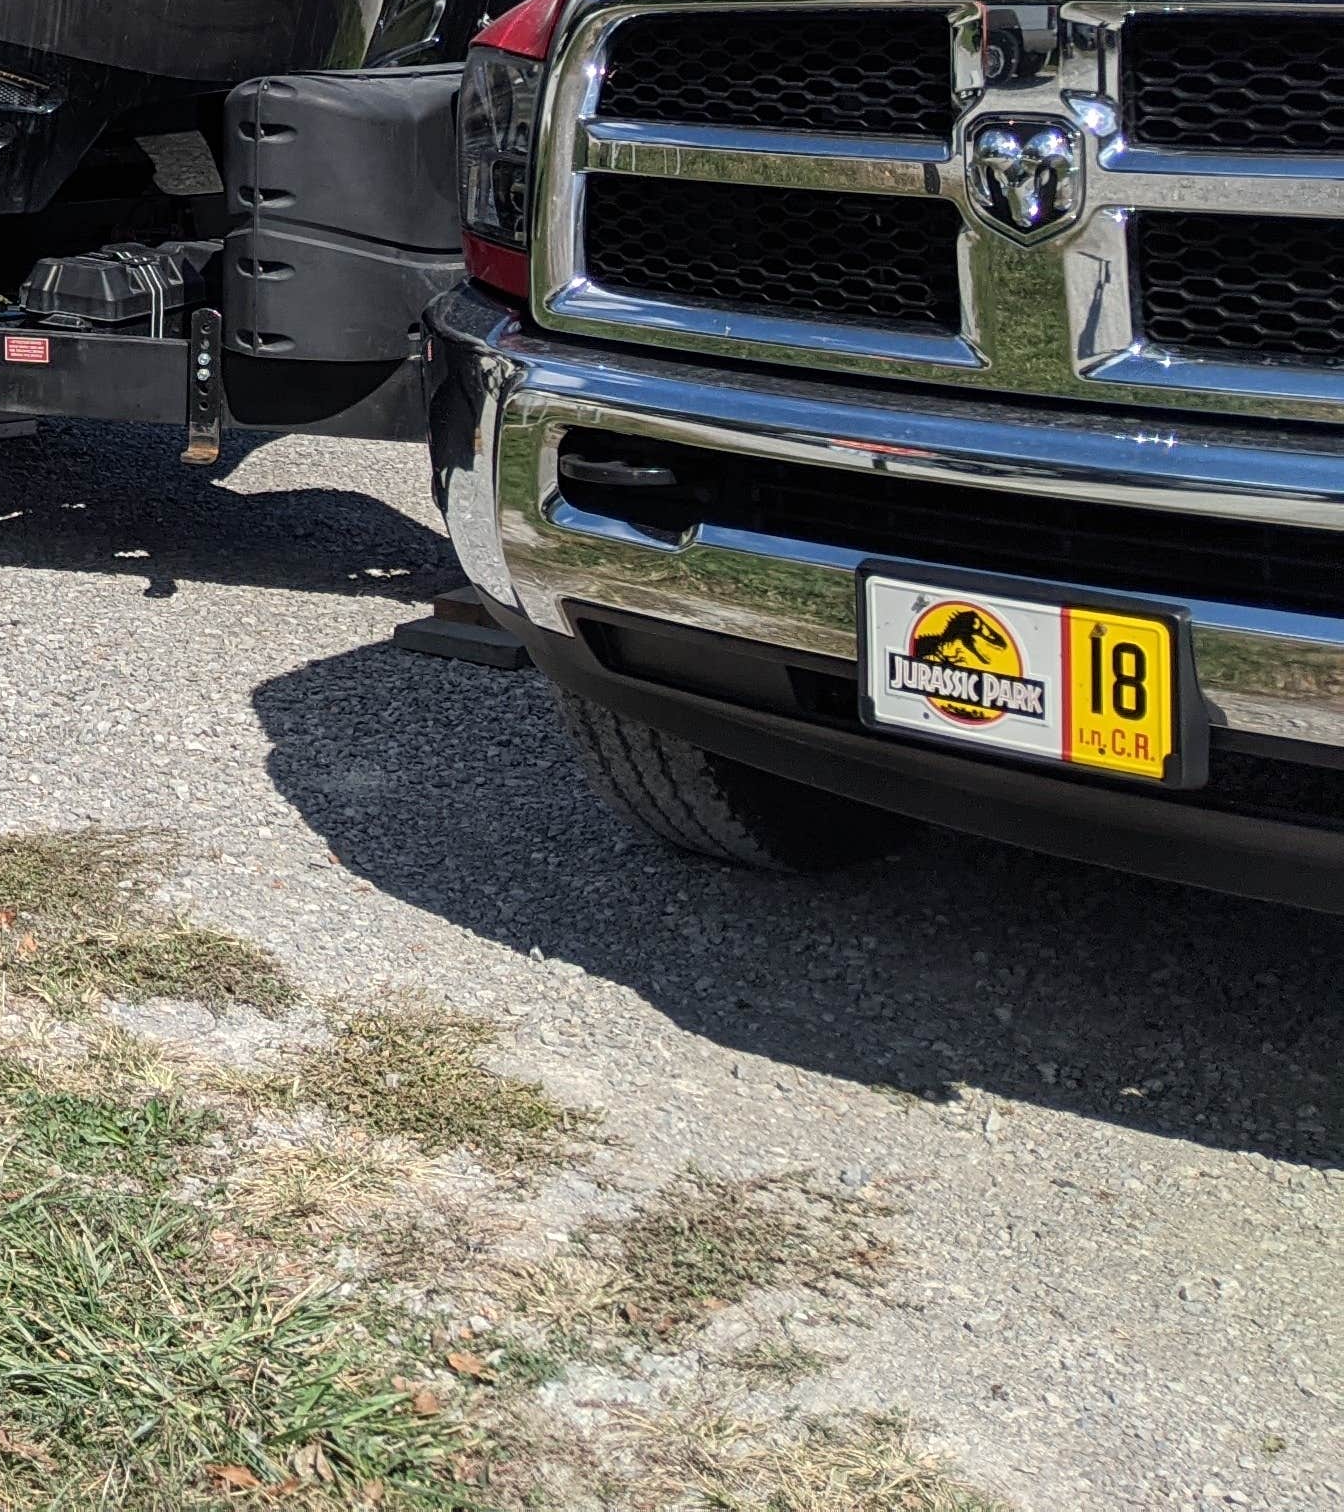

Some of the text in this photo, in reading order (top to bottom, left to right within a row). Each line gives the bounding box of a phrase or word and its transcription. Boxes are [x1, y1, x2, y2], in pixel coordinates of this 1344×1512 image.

[890, 655, 1043, 714] JURASSIC PARK
[1090, 634, 1147, 721] 18
